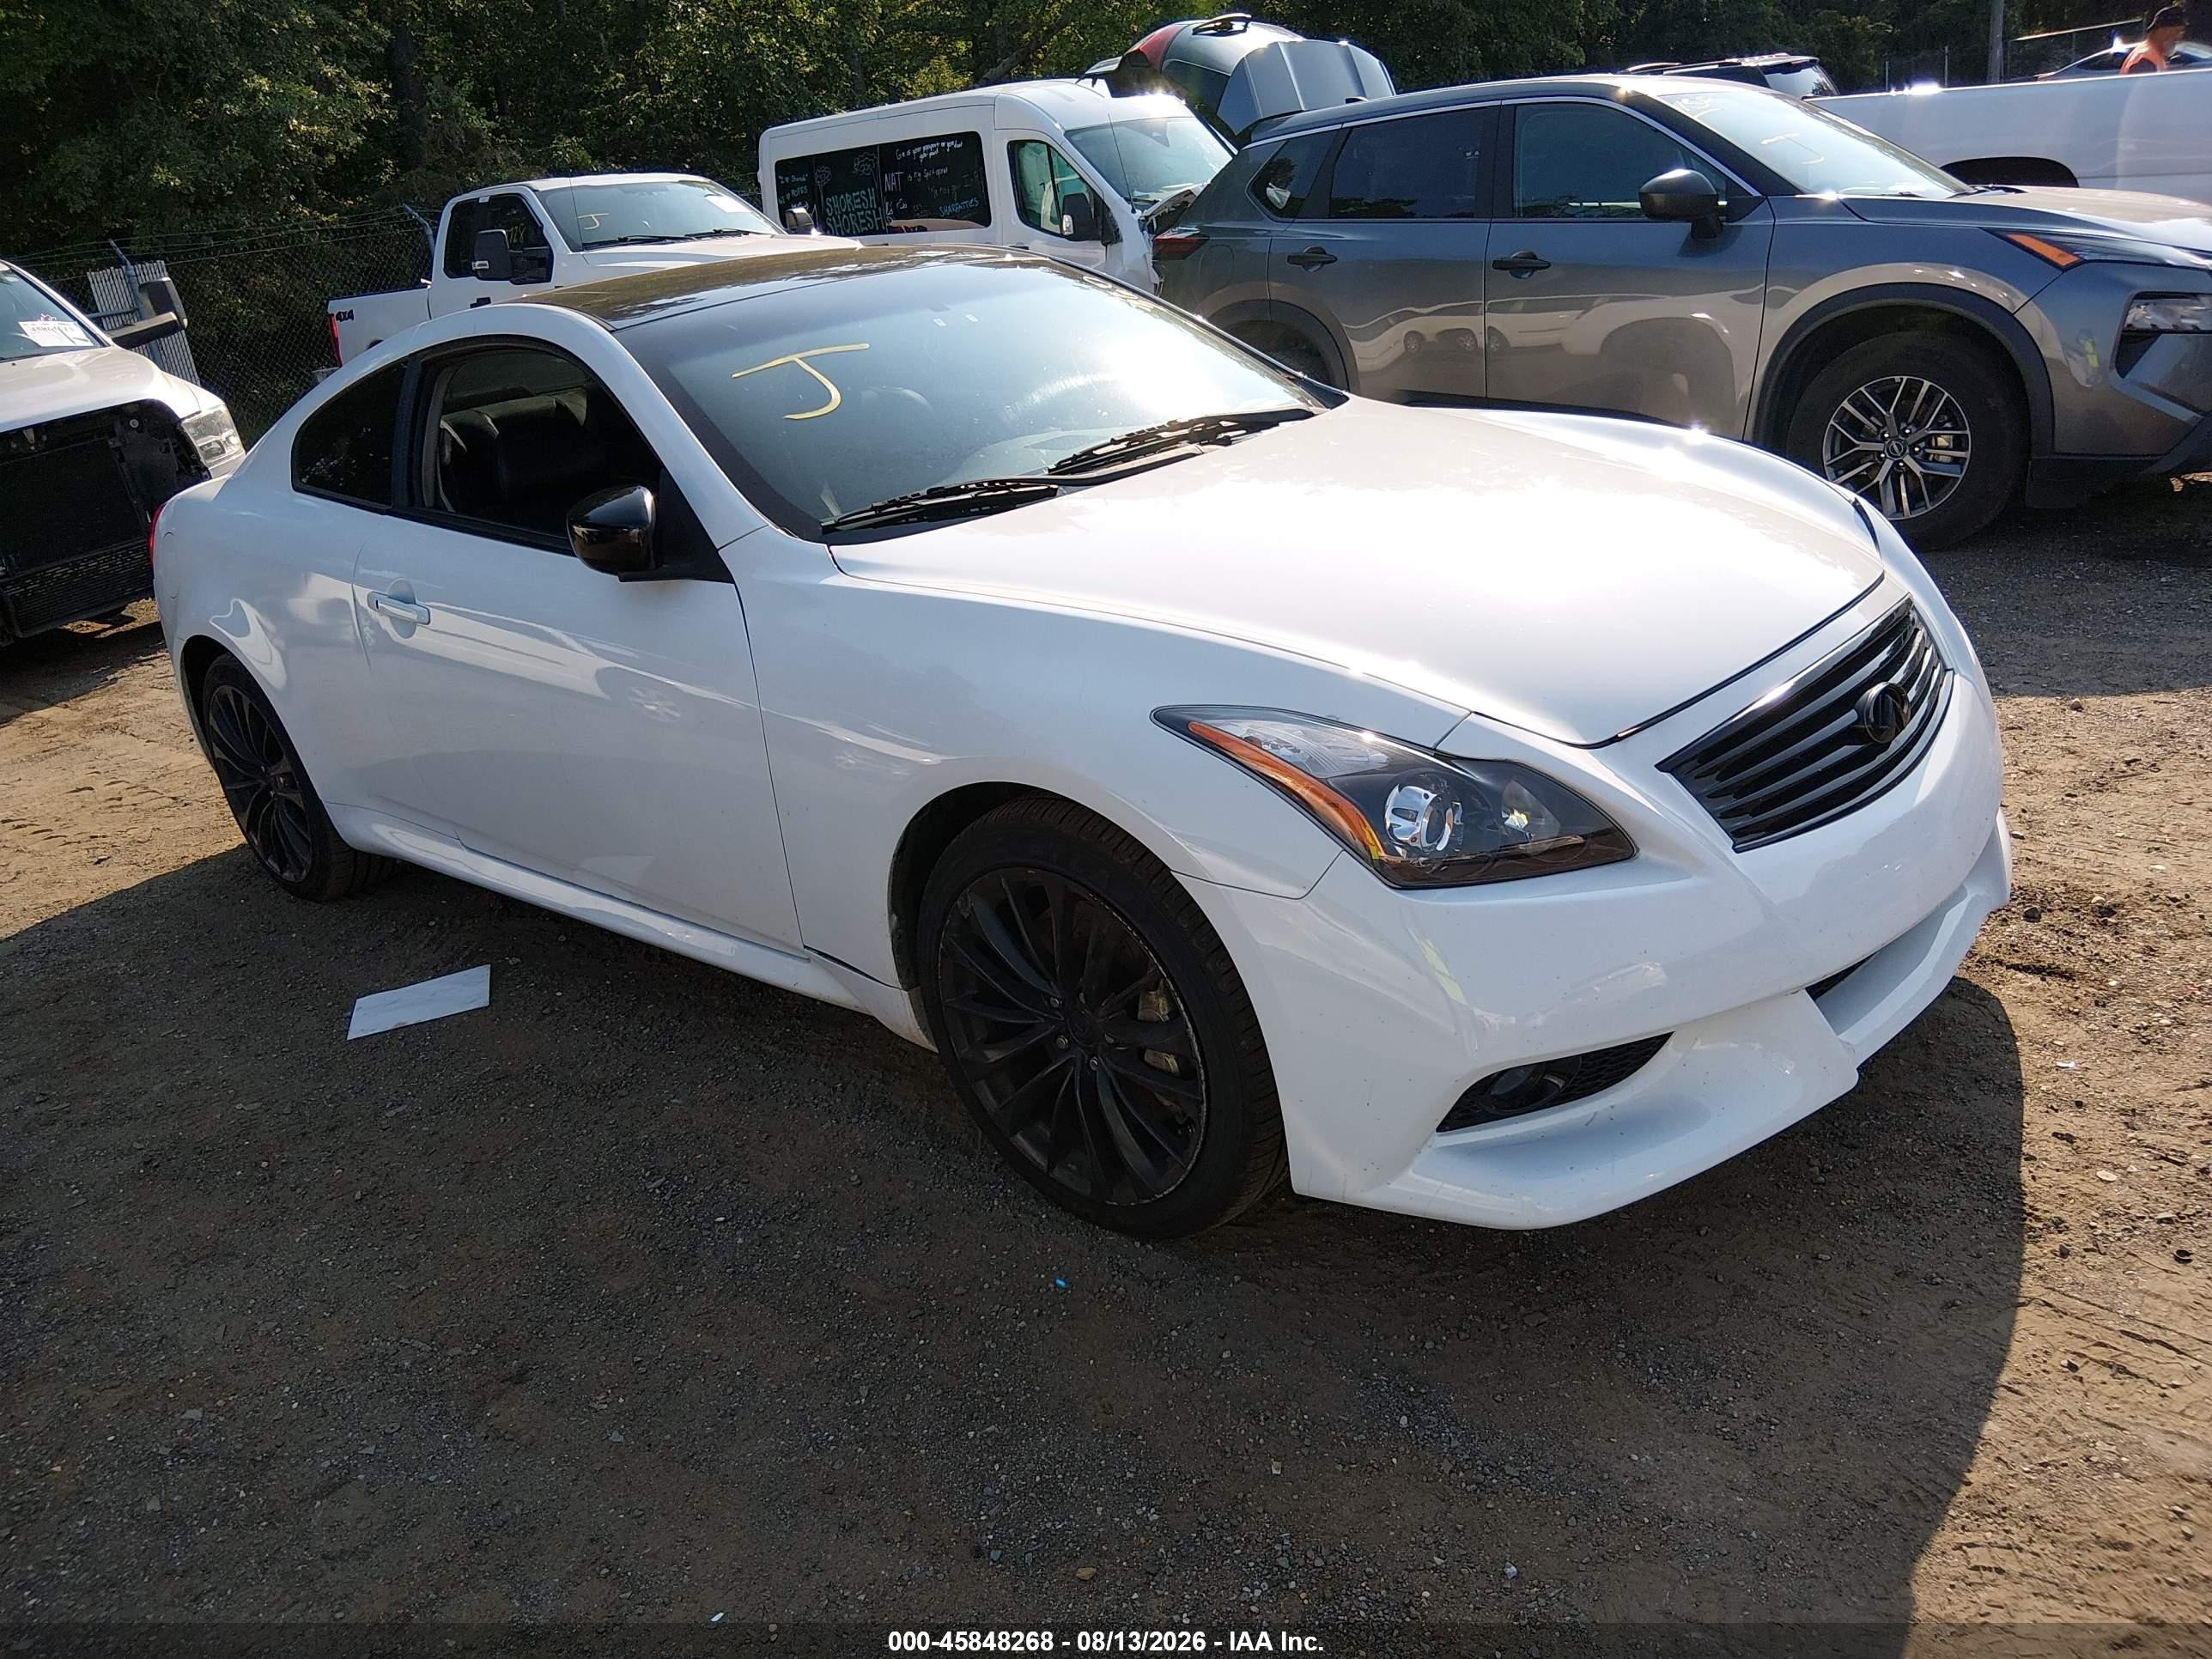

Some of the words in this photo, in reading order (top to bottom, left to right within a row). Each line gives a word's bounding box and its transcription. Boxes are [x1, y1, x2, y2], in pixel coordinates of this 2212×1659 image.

[884, 171, 905, 192] NAT
[825, 187, 877, 216] SHORESH
[825, 207, 886, 235] SHORESH
[730, 343, 870, 420] J
